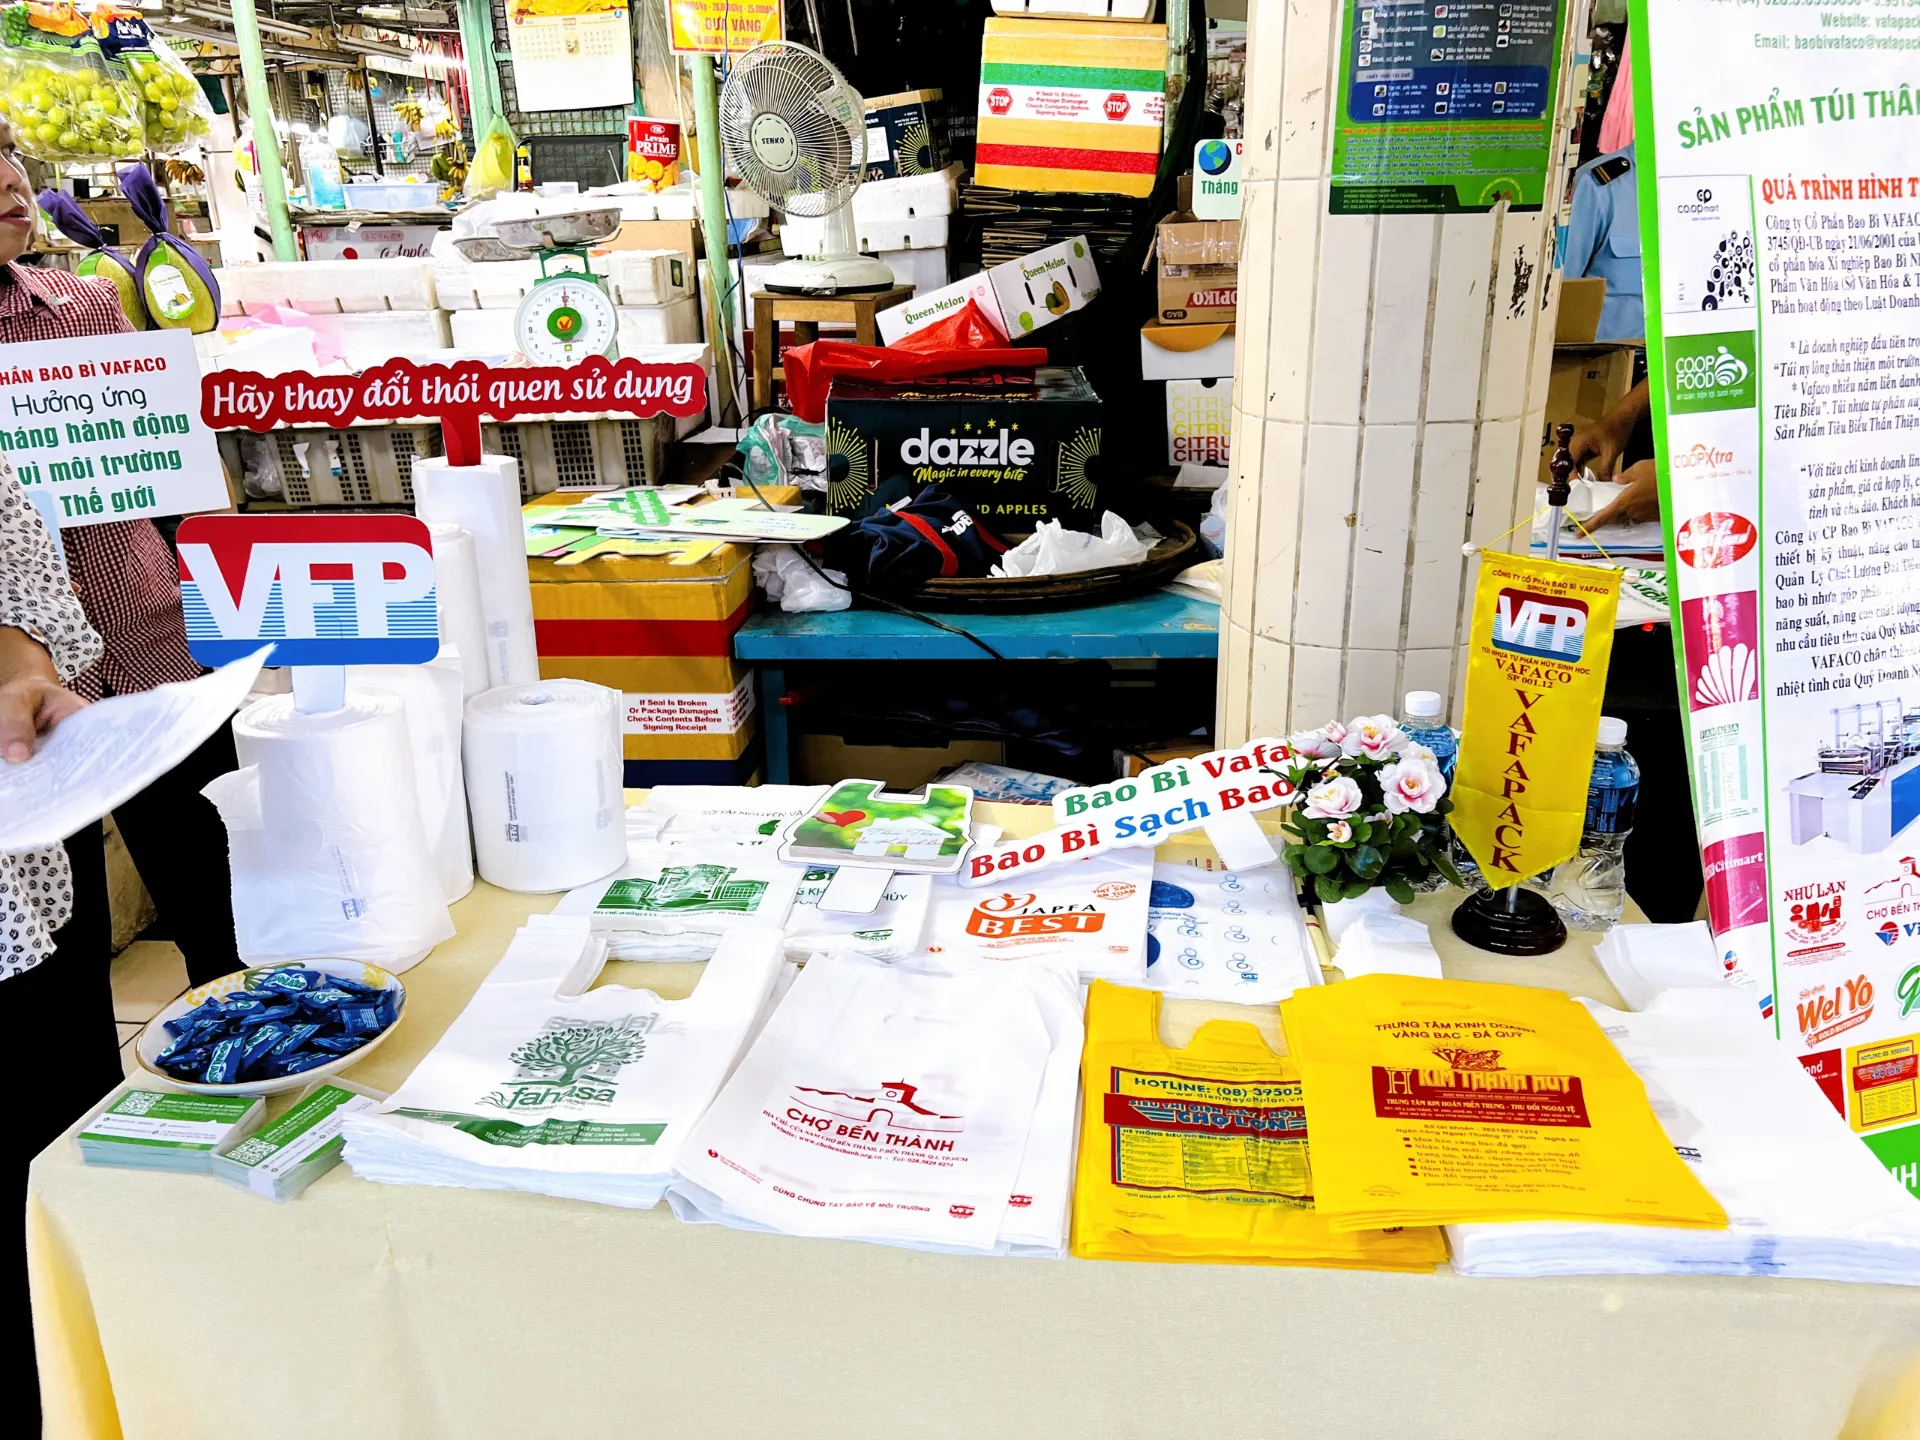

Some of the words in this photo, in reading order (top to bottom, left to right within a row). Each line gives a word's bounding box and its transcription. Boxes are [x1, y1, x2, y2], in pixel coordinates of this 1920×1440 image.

[731, 16, 761, 32] VÀNG
[1821, 12, 1872, 27] Website:
[1755, 33, 1790, 49] Email:
[990, 95, 1010, 107] STOP
[1106, 101, 1127, 113] STOP
[1677, 106, 1731, 149] SẢN
[1735, 87, 1805, 135] PHẨM
[1810, 87, 1855, 124] TÚI
[1863, 82, 1920, 118] THÂ
[635, 140, 677, 155] PRIME
[644, 133, 670, 143] Levain
[1201, 180, 1238, 195] Tháng
[1762, 173, 1797, 205] QUÁ
[1800, 173, 1854, 200] TRÌNH
[1857, 172, 1903, 200] HÌNH
[1825, 237, 1846, 254] ngày
[1848, 233, 1895, 249] 21/06/2001
[1023, 264, 1045, 281] Queen
[1044, 256, 1066, 272] Melon
[905, 306, 935, 325] Queen
[936, 294, 965, 312] Melon
[39, 365, 73, 382] BAO
[79, 360, 96, 378] BÌ
[100, 356, 167, 376] VAFACO
[1676, 371, 1715, 390] FOOD
[12, 389, 93, 416] Hưởng
[101, 386, 147, 409] ứng
[213, 381, 274, 421] Hãy
[283, 381, 354, 417] thay
[363, 368, 411, 407] đổi
[421, 371, 479, 404] thói
[488, 378, 564, 411] quen
[570, 368, 609, 400] sử
[613, 370, 693, 405] dụng
[65, 418, 125, 443] hành
[133, 412, 190, 440] động
[1173, 423, 1231, 436] CITRU
[900, 428, 1035, 465] dazzle
[1173, 436, 1230, 449] CITRU
[1173, 449, 1229, 461] CITRU
[17, 461, 41, 486] vì
[49, 456, 94, 482] môi
[100, 449, 182, 477] trường
[912, 466, 956, 484] Magic
[957, 468, 969, 478] in
[969, 468, 1003, 484] every
[1003, 466, 1028, 481] bite
[60, 487, 103, 517] Thế
[111, 485, 156, 513] giới
[996, 504, 1047, 515] APPLES
[1775, 530, 1804, 545] Công
[1822, 526, 1836, 540] CP
[1841, 523, 1858, 537] Bao
[176, 542, 433, 639] VFP
[1492, 569, 1511, 579] CÔNG
[1513, 574, 1521, 582] TY
[1521, 575, 1532, 583] CỔ
[1533, 577, 1550, 586] PHẦN
[1552, 580, 1568, 589] BAO
[1569, 582, 1577, 590] BÌ
[1580, 585, 1609, 595] VAFACO
[1527, 584, 1548, 594] SINCE
[1550, 588, 1567, 596] 1991
[1499, 595, 1587, 652] VFP
[1481, 646, 1491, 655] TÚI
[1491, 650, 1509, 660] NHỰA
[1510, 654, 1518, 662] TỰ
[1519, 655, 1539, 665] PHÂN
[1540, 657, 1555, 668] HỦY
[1557, 663, 1575, 673] SINH
[1575, 666, 1591, 676] HỌC
[1811, 650, 1861, 670] VAFACO
[1496, 658, 1572, 684] VAFACO
[1507, 673, 1520, 681] SP
[1521, 676, 1553, 689] 001.12
[1776, 681, 1805, 697] nhiệt
[1808, 678, 1829, 693] tình
[1832, 673, 1851, 690] của
[1854, 670, 1875, 689] Quý
[1878, 666, 1909, 683] Doanh
[641, 707, 677, 715] Package
[677, 699, 707, 707] Broken
[1065, 784, 1137, 817] Bao
[1151, 765, 1191, 794] Bì
[1201, 744, 1302, 779] Vafa
[1489, 688, 1545, 874] VAFAPACK
[970, 843, 1045, 879] Bao
[1060, 823, 1100, 854] Bì
[1114, 798, 1211, 839] Sạch
[1218, 779, 1295, 811] Bao
[1783, 883, 1815, 902] NHƯ
[1816, 880, 1846, 898] LAN
[1018, 904, 1097, 915] JAPFA
[1866, 906, 1888, 920] CHỢ
[1891, 901, 1910, 916] BẾN
[977, 914, 1097, 935] BEST
[1796, 986, 1841, 1034] Wel
[1843, 973, 1873, 1011] Yo
[1375, 1021, 1420, 1031] TRUNG
[1422, 1021, 1451, 1029] TÂM
[1455, 1021, 1487, 1029] KINH
[1489, 1022, 1537, 1034] DOANH
[1392, 1029, 1430, 1039] VÀNG
[1433, 1032, 1462, 1042] BẠC
[1472, 1029, 1491, 1039] ĐÁ
[1495, 1030, 1523, 1039] QUÝ
[1134, 1077, 1211, 1093] HOTLINE:
[1216, 1086, 1248, 1098] (08)
[1418, 1069, 1456, 1088] KIM
[1531, 1075, 1571, 1094] HUY
[786, 1107, 833, 1132] CHỢ
[836, 1125, 879, 1143] BẾN
[885, 1134, 954, 1152] THÀNH
[1176, 1110, 1232, 1129] CHỢ
[772, 1184, 796, 1199] CÙNG
[797, 1195, 826, 1207] CHUNG
[845, 1201, 865, 1209] BẢO
[896, 1202, 930, 1213] TRƯỜNG
